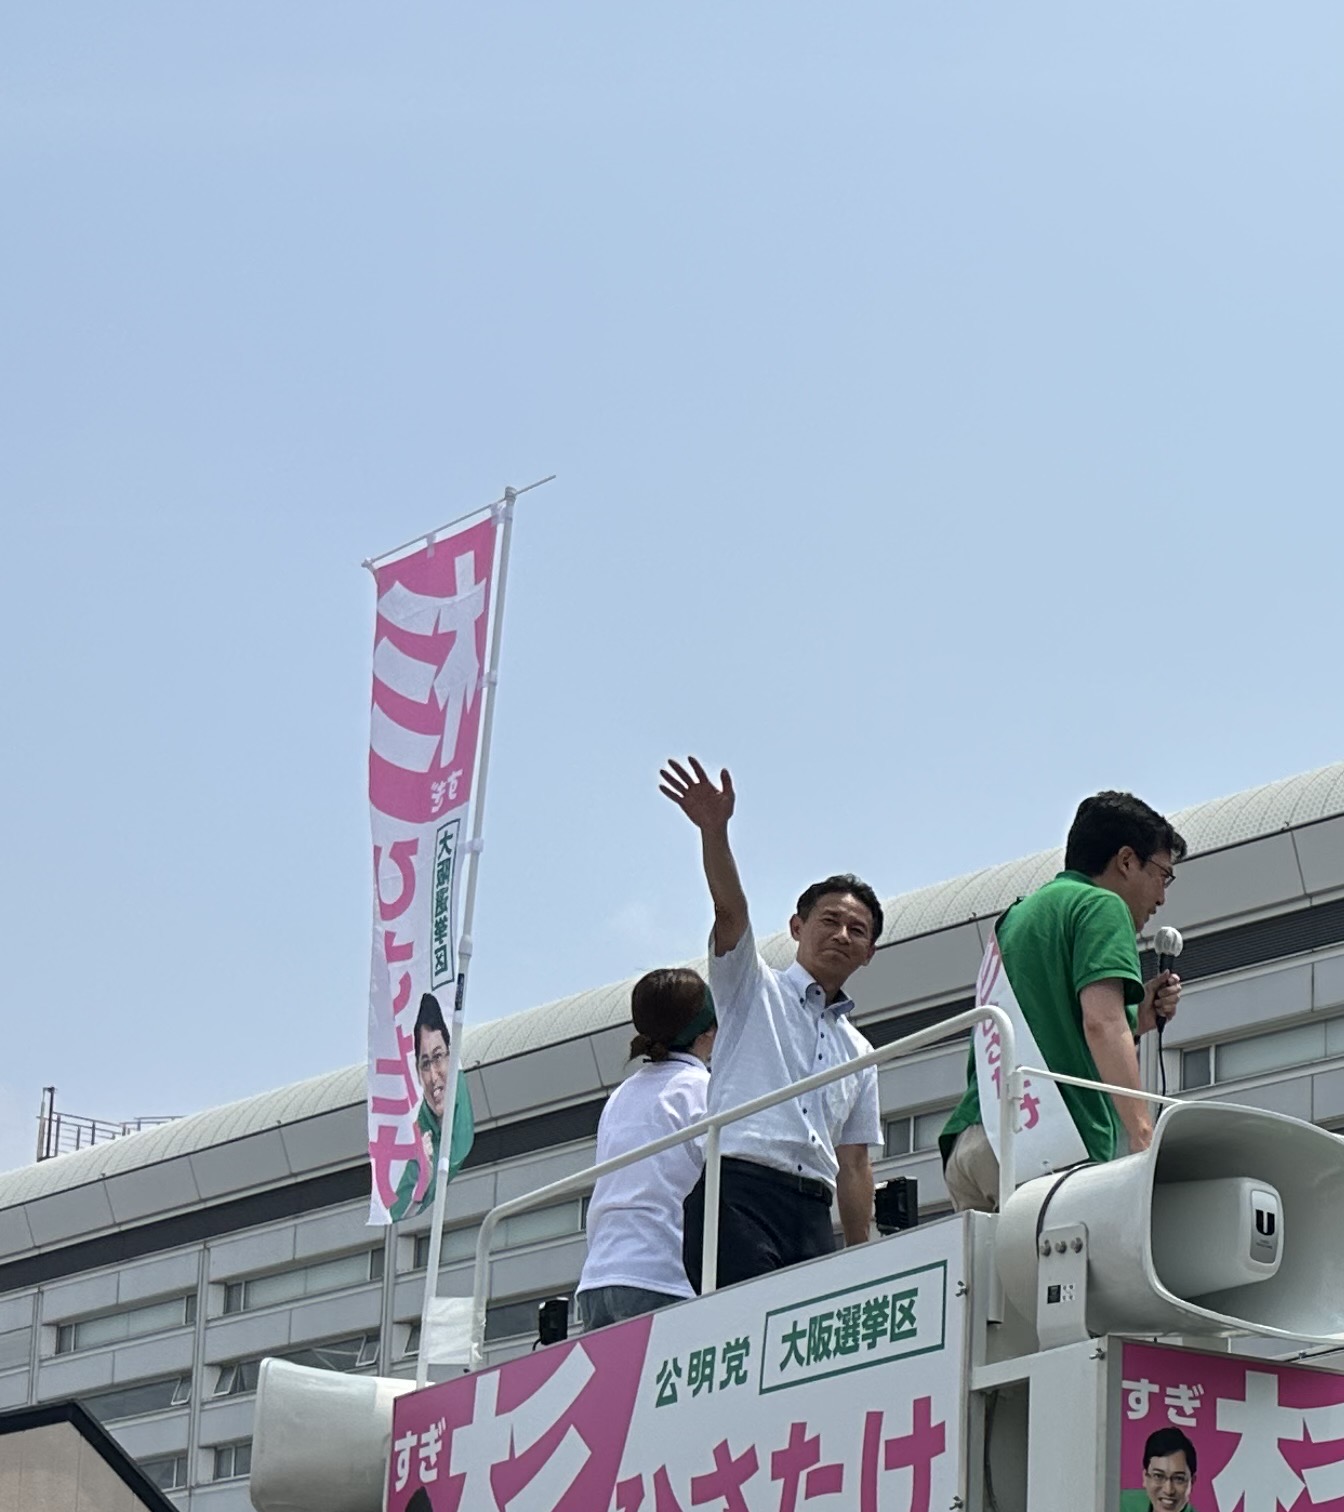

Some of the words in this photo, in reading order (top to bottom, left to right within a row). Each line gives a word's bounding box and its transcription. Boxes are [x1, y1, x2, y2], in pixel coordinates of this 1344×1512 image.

[779, 1287, 920, 1372] 大阪選挙区
[656, 1337, 750, 1407] 公明党
[1121, 1377, 1204, 1428] すぎ
[393, 1417, 447, 1486] すぎ
